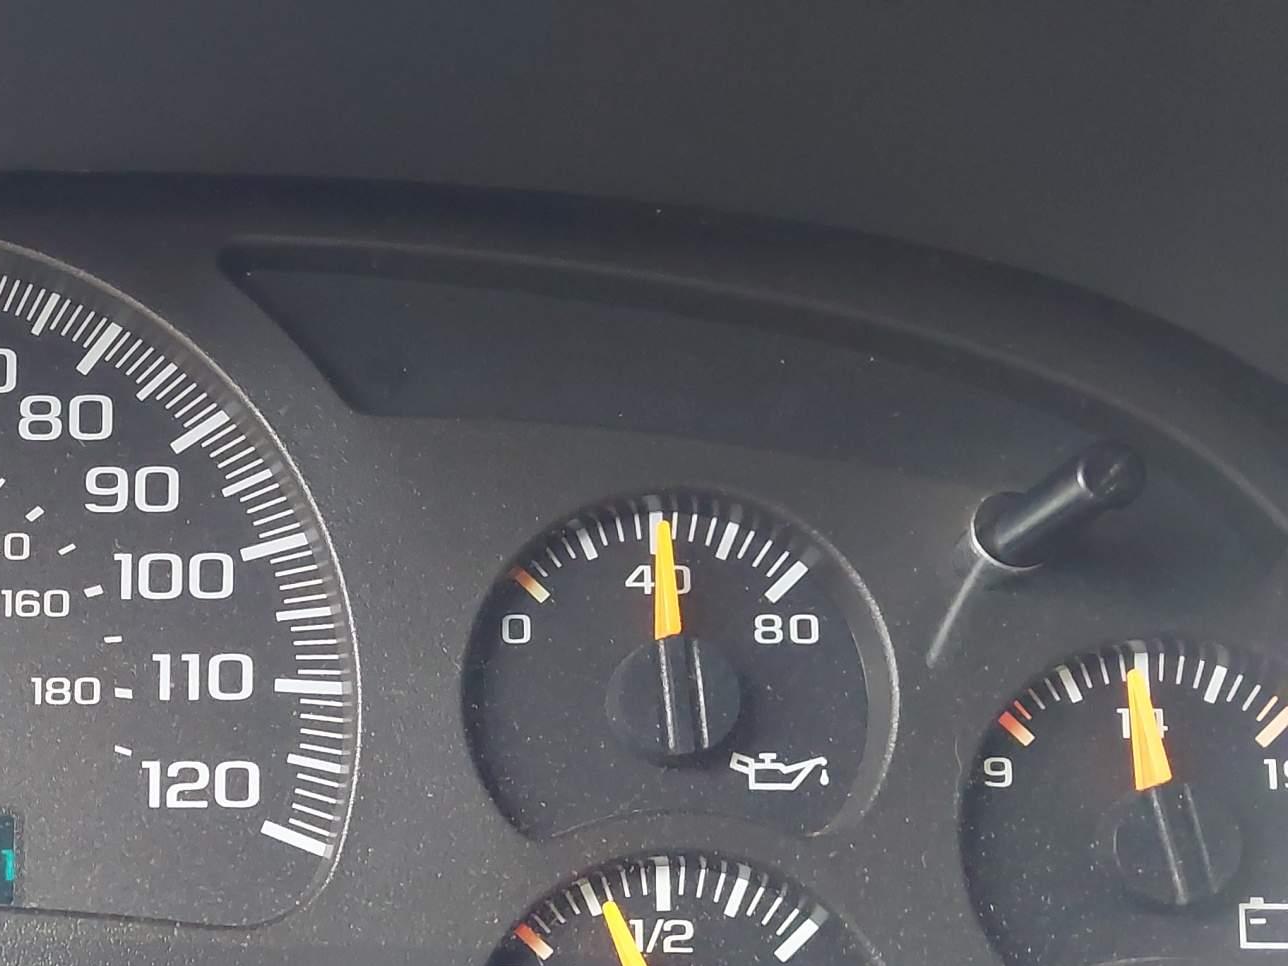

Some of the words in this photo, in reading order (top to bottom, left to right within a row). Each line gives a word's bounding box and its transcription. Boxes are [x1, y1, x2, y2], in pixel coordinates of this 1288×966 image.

[18, 394, 113, 441] 80
[84, 465, 180, 513] 90
[114, 552, 234, 600] 100
[1, 589, 70, 618] 160
[501, 613, 532, 645] 0
[753, 613, 820, 645] 80
[30, 677, 101, 705] 180
[151, 653, 254, 701] 110
[141, 760, 261, 809] 120
[983, 757, 1013, 788] 9
[1263, 758, 1288, 790] 1
[628, 918, 694, 953] 1/2
